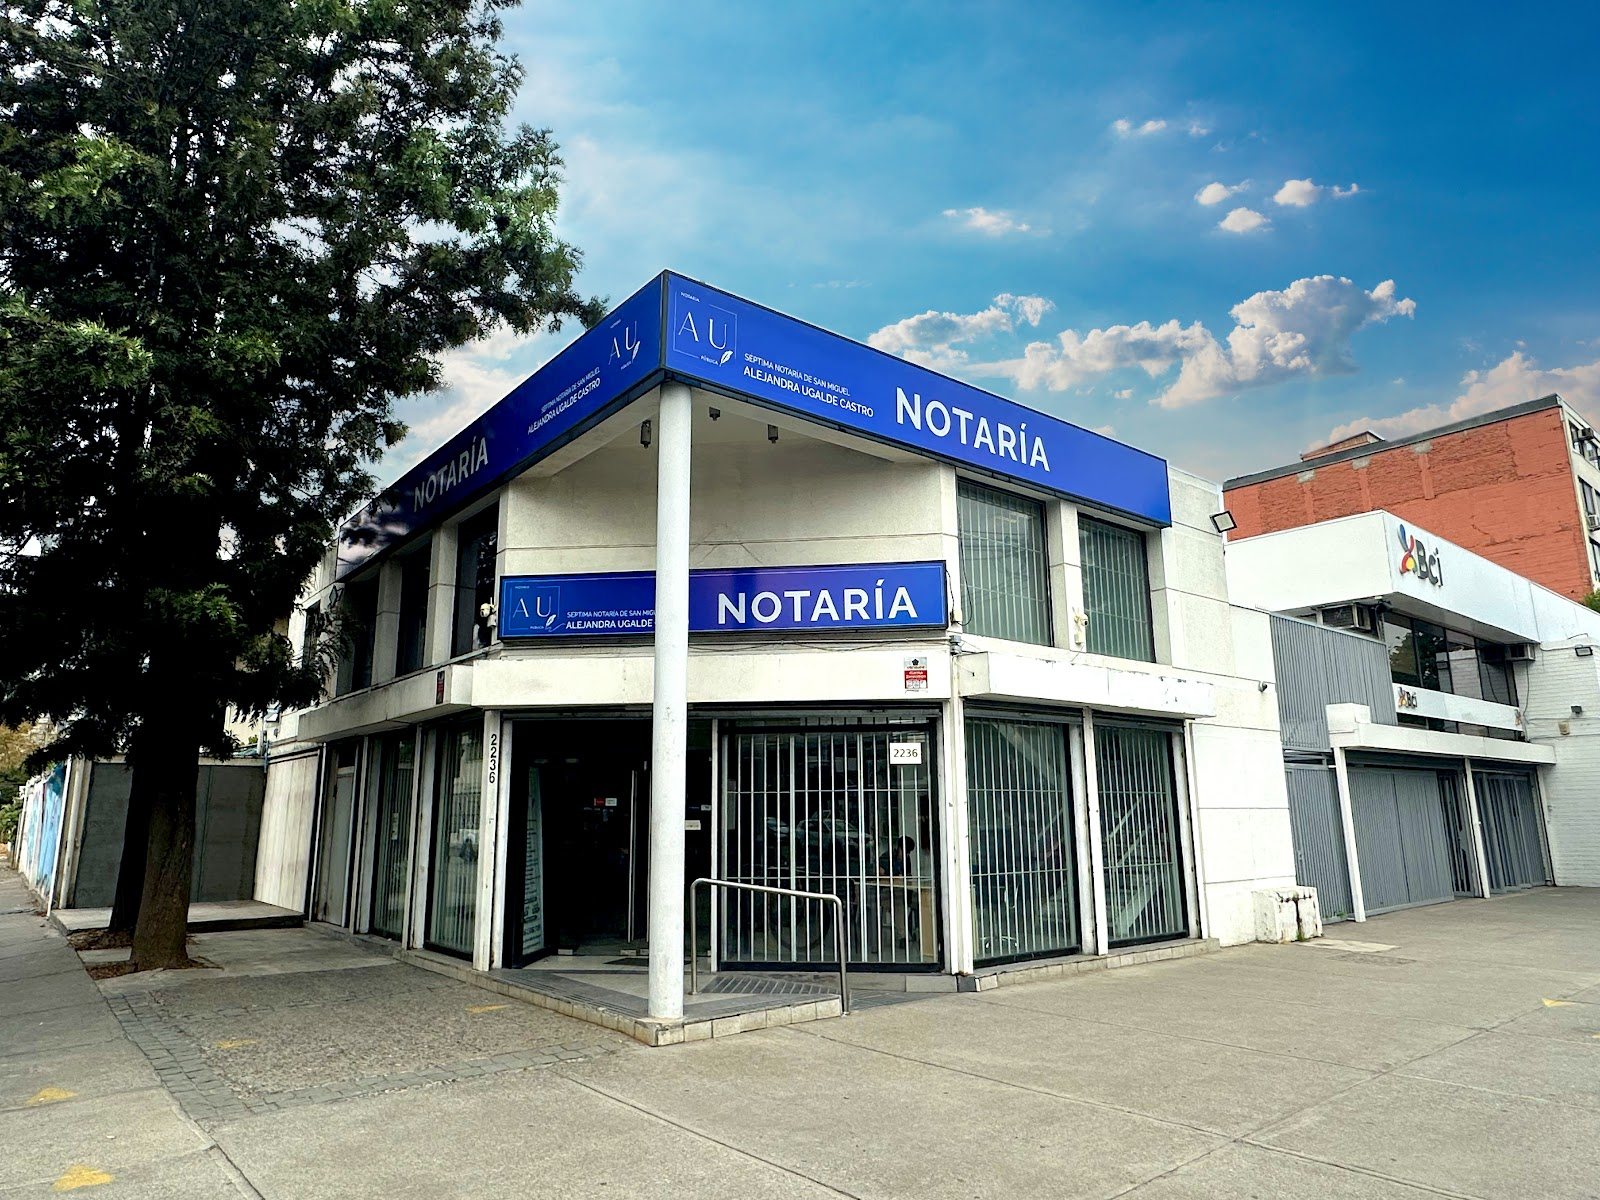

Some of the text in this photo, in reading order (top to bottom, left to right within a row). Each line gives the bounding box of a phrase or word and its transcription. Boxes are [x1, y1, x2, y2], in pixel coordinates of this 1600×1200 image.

[527, 377, 600, 435] ALEJANDRA UGALDE CASTRO
[743, 365, 874, 418] ALEJANDRA UGALDE CASTRO
[803, 373, 813, 383] DE
[813, 377, 827, 388] SAN
[827, 382, 851, 397] MIGUEL
[896, 386, 1050, 472] NOTARÍA
[414, 435, 489, 513] NOTARÍA
[1415, 539, 1444, 589] Bci
[565, 618, 653, 630] ALEJANDRA UGALDE
[717, 578, 918, 625] NOTARÍA
[488, 733, 497, 784] 2236
[893, 748, 918, 758] 2236
